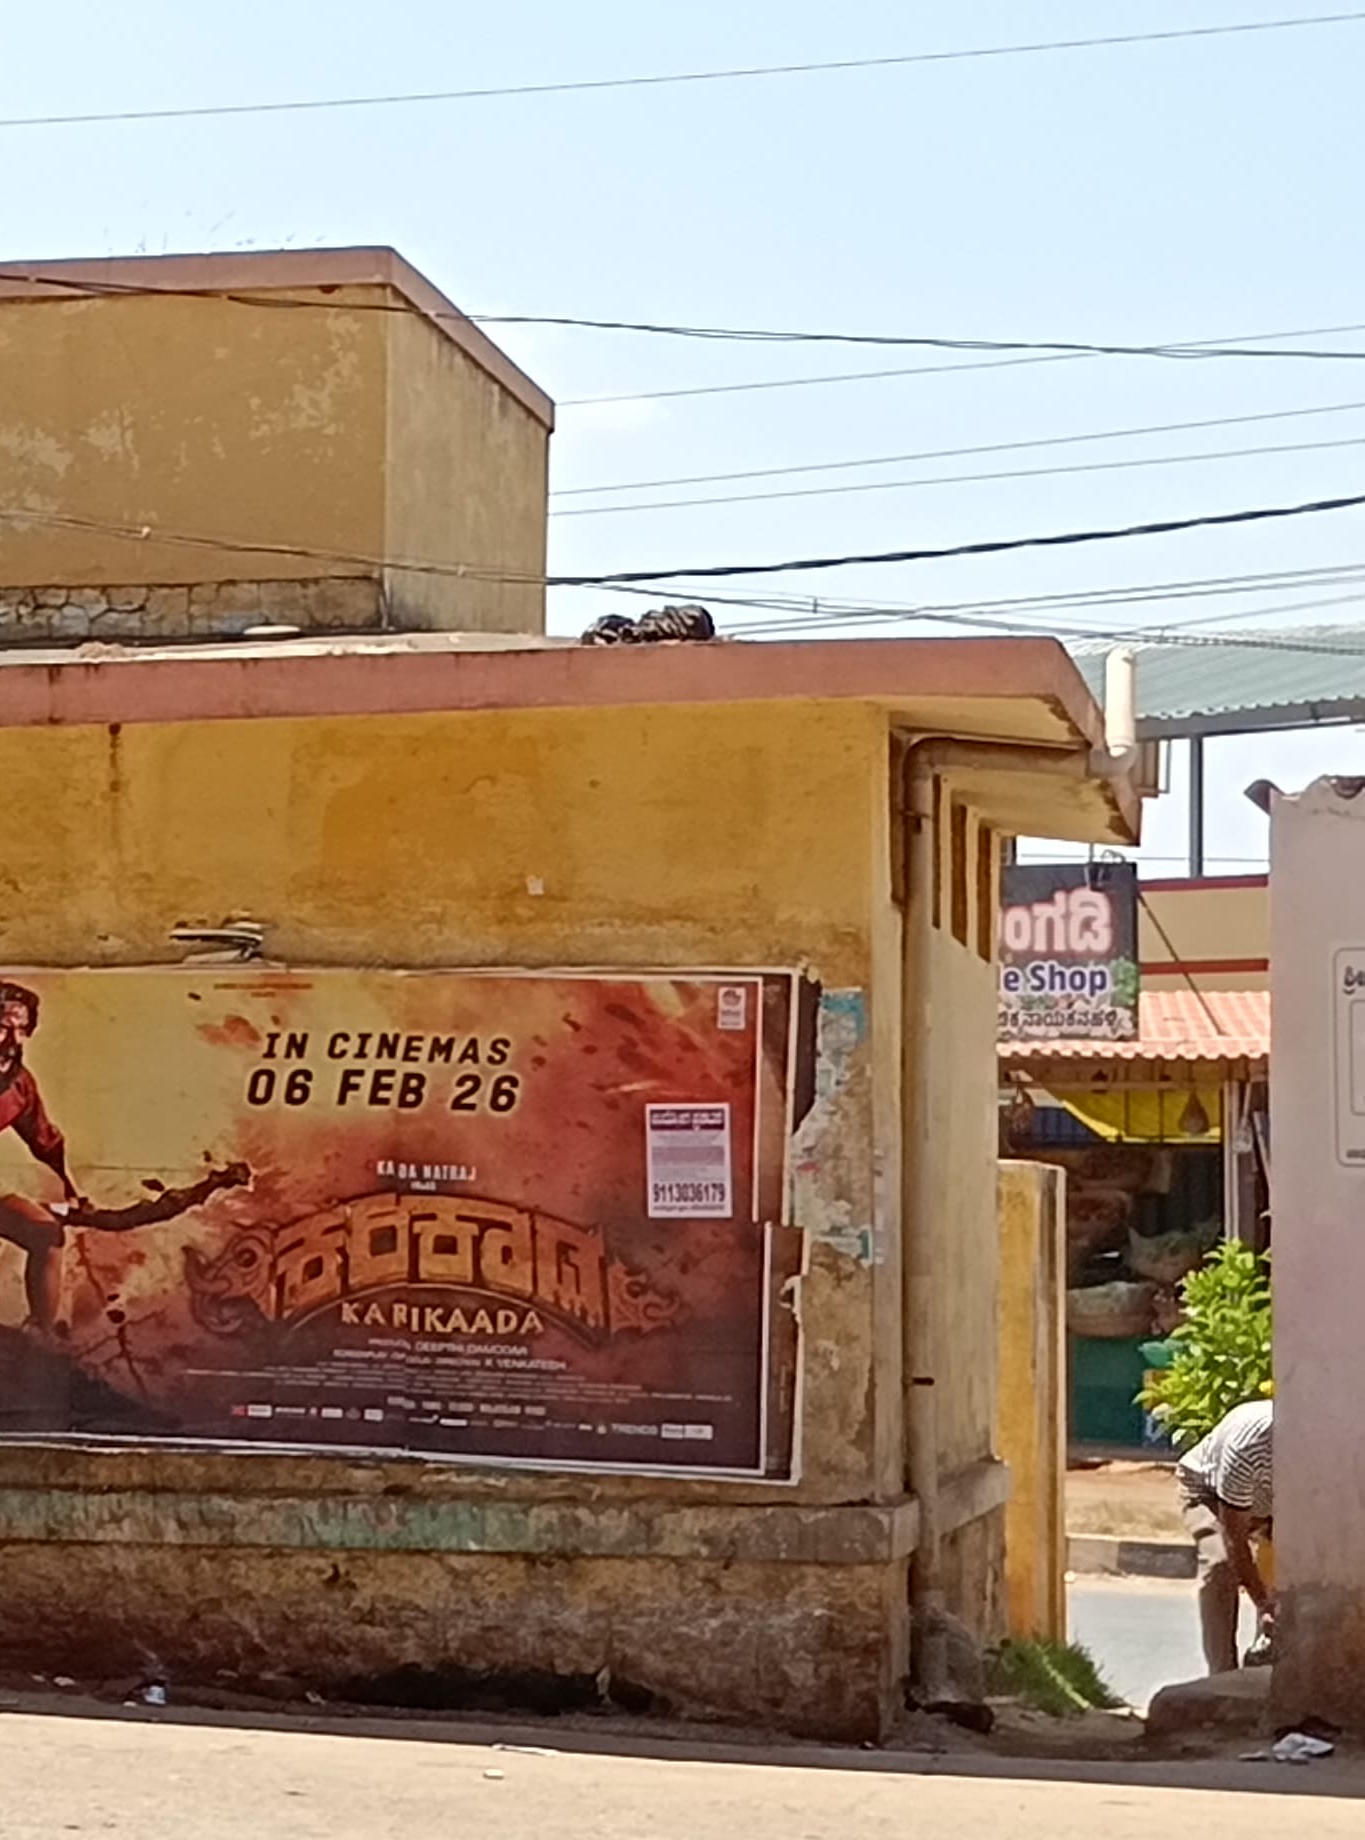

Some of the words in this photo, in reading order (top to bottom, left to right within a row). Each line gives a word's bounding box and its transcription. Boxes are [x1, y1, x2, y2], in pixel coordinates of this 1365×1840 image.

[998, 887, 1112, 953] ಂಗಡಿ
[1030, 964, 1108, 997] Shop
[261, 1033, 309, 1060] IN
[326, 1032, 512, 1066] CINEMAS
[247, 1068, 313, 1106] 06
[336, 1069, 427, 1109] FEB
[450, 1074, 520, 1112] 26
[653, 1183, 726, 1203] 9113036179
[341, 1302, 544, 1335] KARIKAADA
